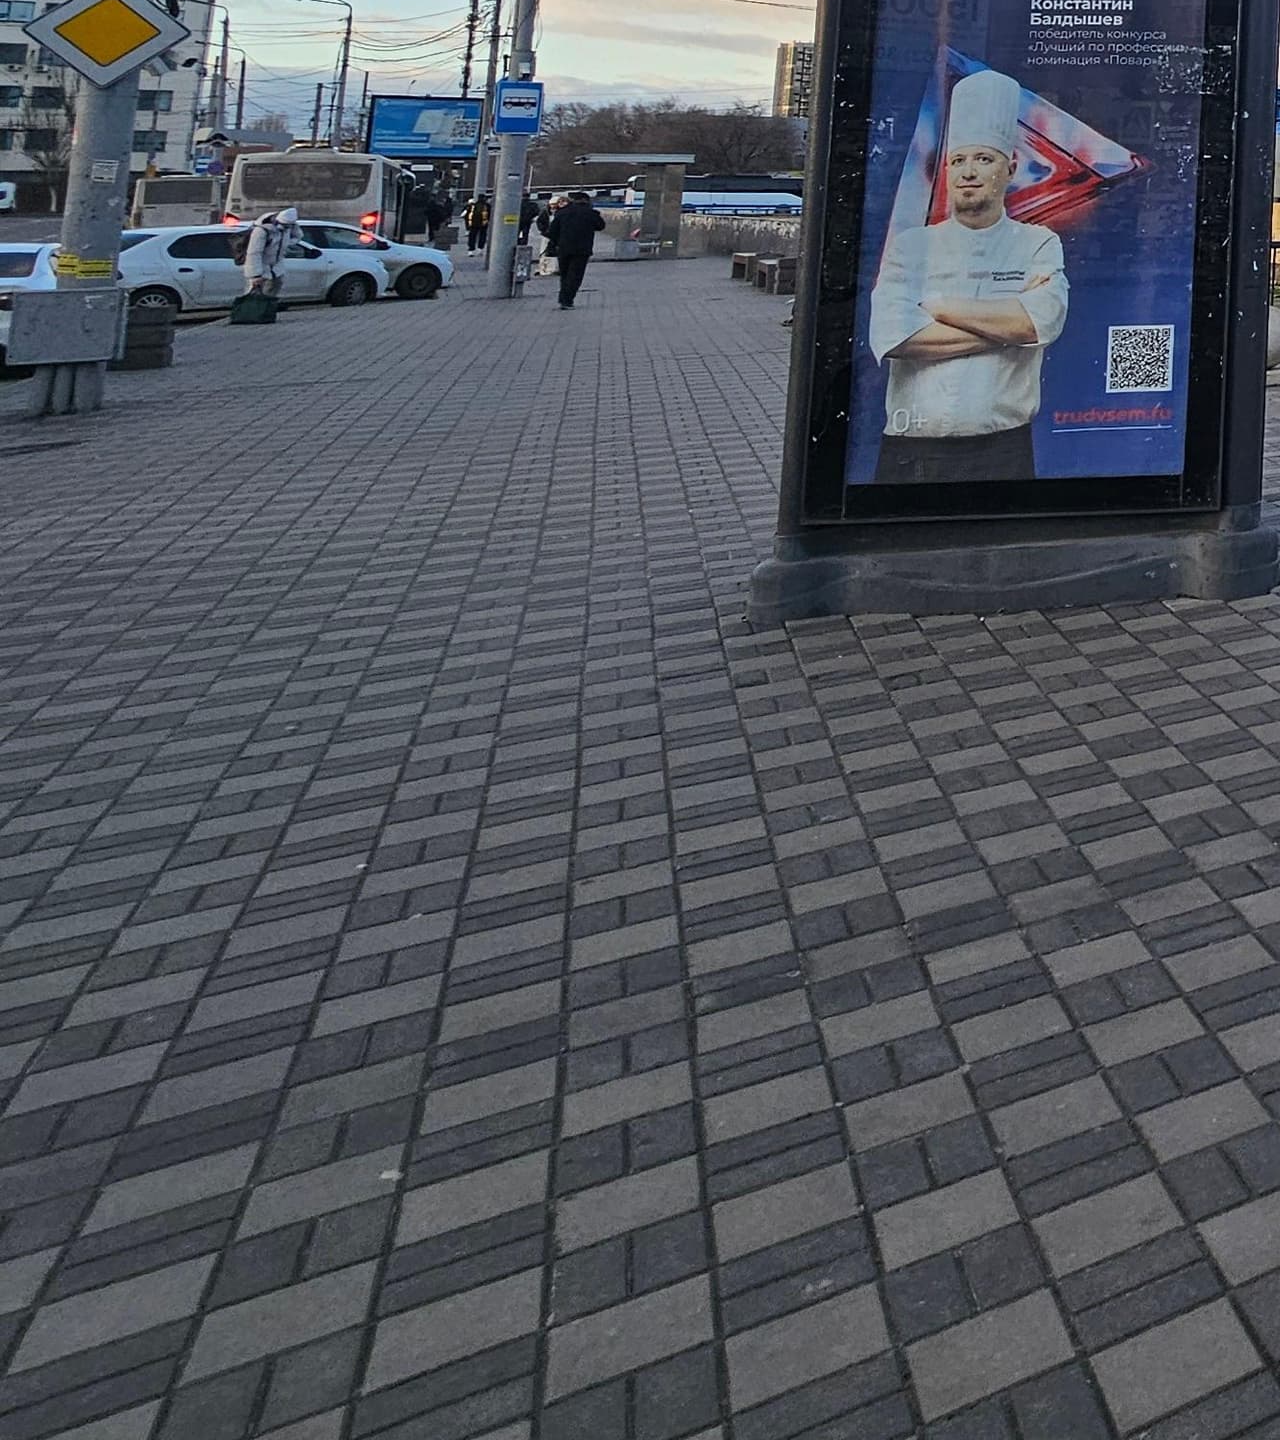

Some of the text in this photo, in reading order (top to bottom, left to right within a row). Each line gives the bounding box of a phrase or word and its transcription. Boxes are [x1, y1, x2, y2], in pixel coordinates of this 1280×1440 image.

[1029, 12, 1124, 27] Балдышев
[1028, 28, 1167, 41] победитель конкурса
[1028, 41, 1085, 55] «Лучший
[1087, 43, 1105, 53] по
[1027, 55, 1101, 66] номинация
[892, 408, 928, 433] 0+
